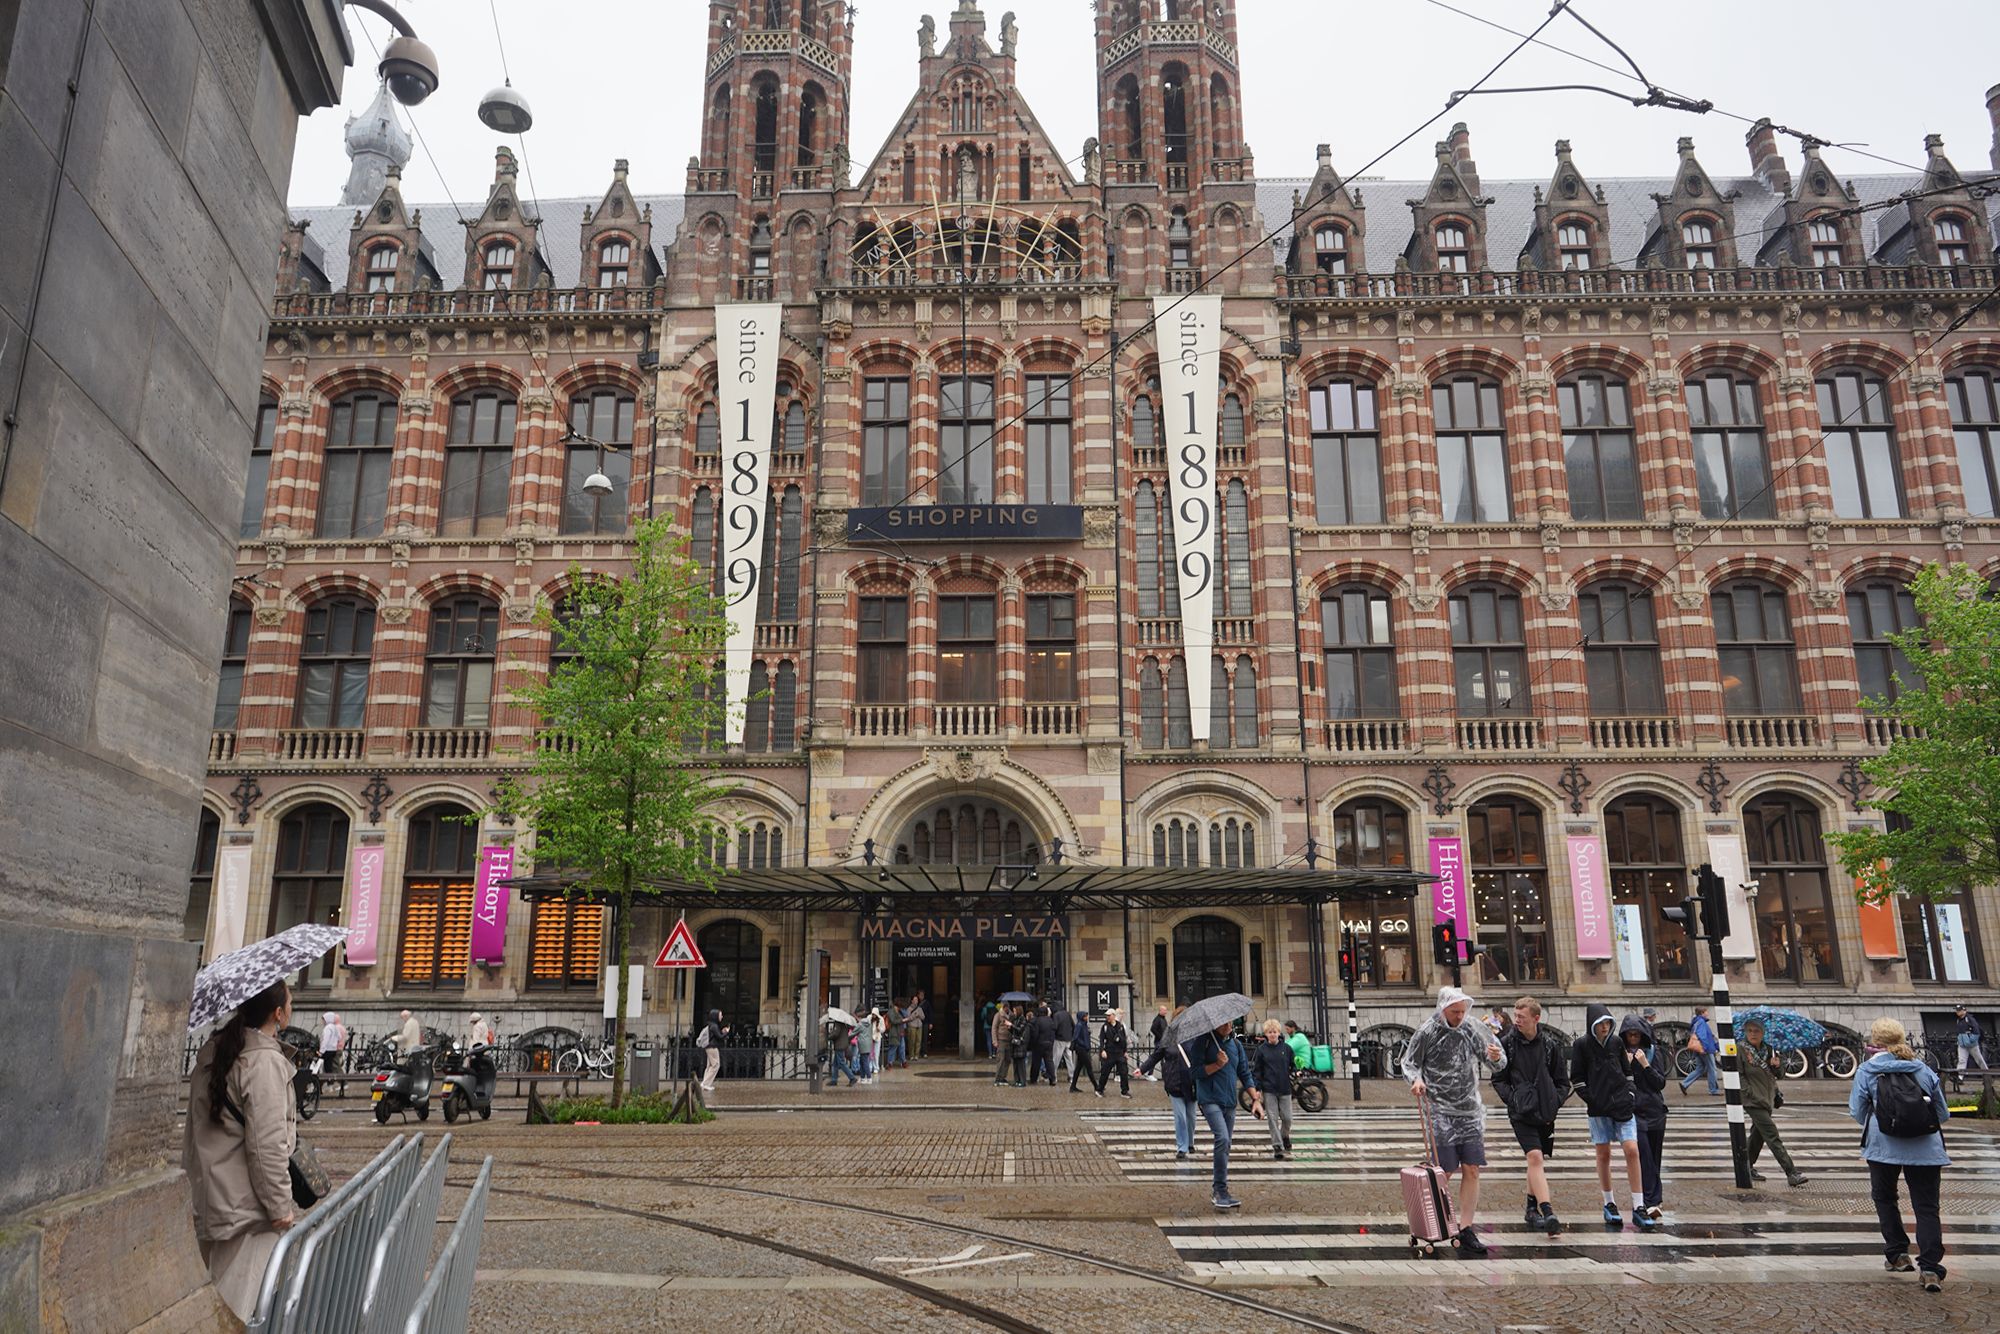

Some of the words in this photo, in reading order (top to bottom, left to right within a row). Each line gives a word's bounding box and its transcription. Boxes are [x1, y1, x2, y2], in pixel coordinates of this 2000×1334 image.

[739, 319, 766, 384] since
[1180, 311, 1206, 376] since
[728, 399, 759, 608] 1899
[888, 507, 1039, 526] SHOPPING
[1180, 391, 1211, 601] 1899
[353, 851, 381, 947] Souvenirs
[478, 851, 512, 927] History
[1437, 843, 1459, 920] History
[1575, 842, 1602, 938] Souvenirs
[861, 918, 966, 938] MAGNA
[976, 918, 1066, 938] PLAZA
[999, 944, 1017, 952] OPEN
